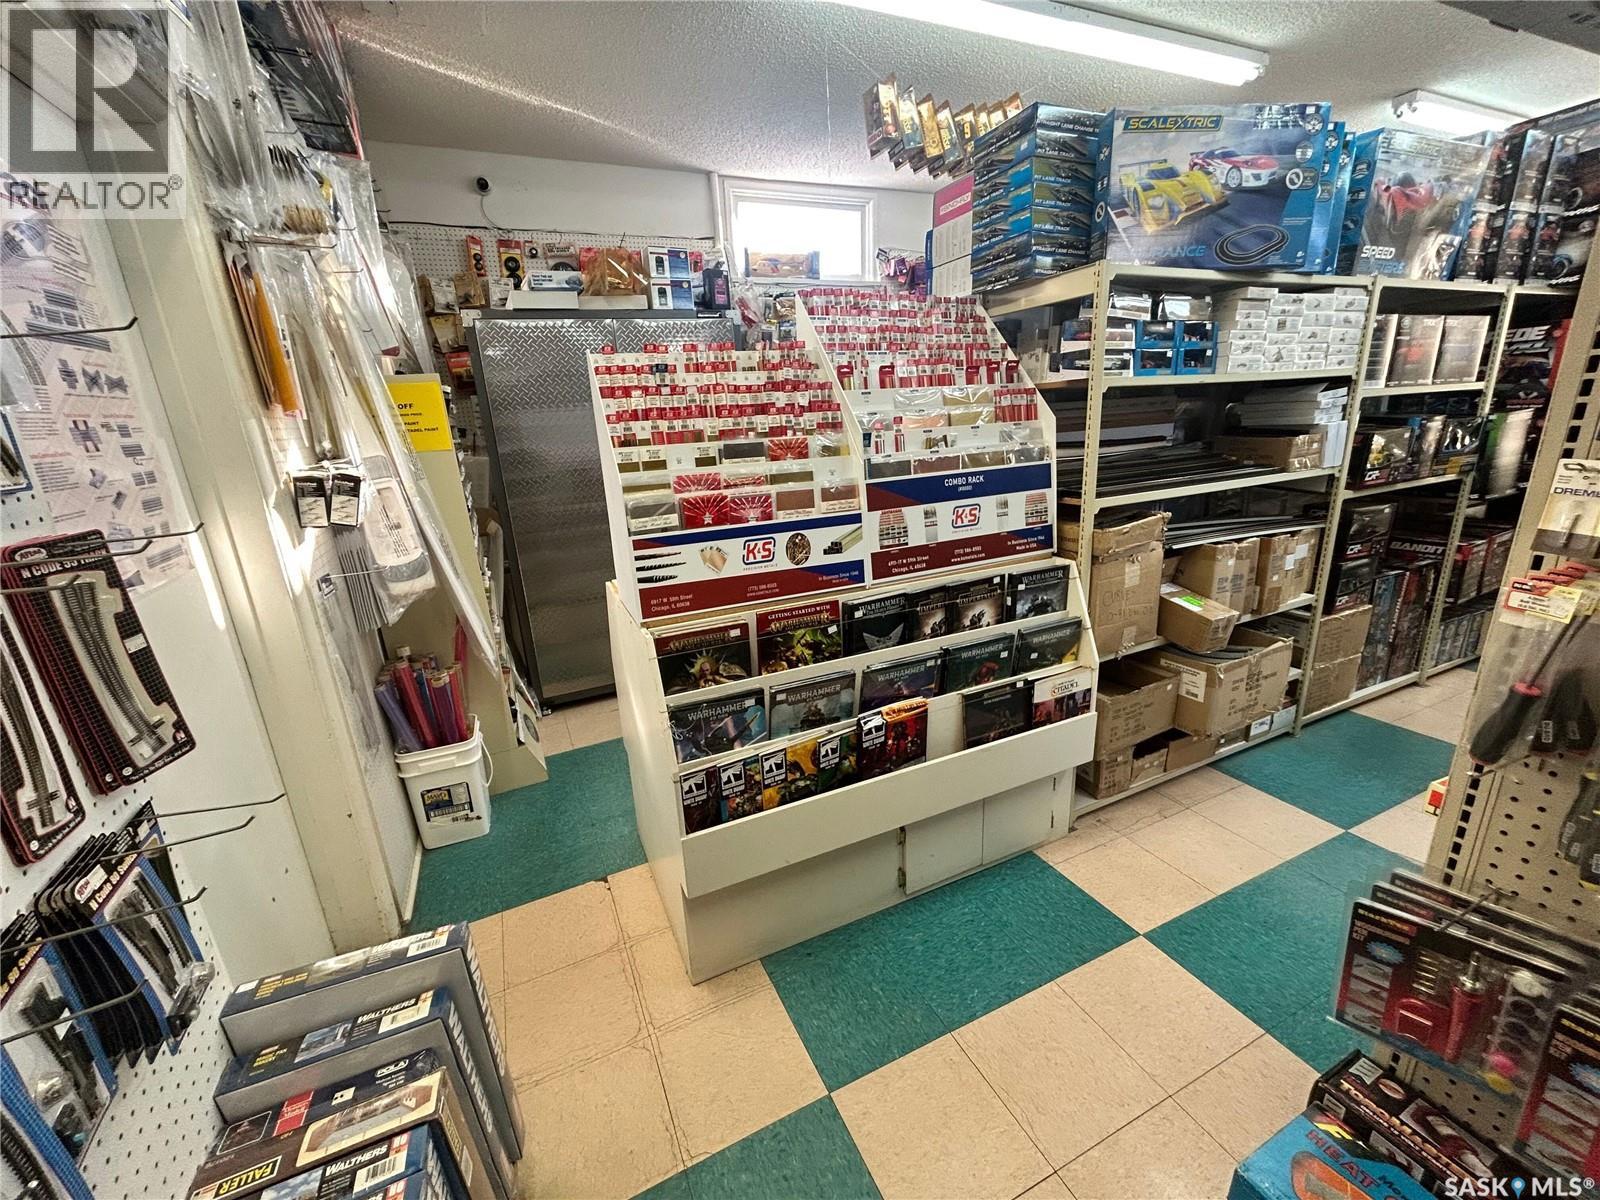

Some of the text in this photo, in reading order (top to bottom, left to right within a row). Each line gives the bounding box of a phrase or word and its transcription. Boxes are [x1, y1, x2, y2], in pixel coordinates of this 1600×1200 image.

[1127, 115, 1219, 131] SCALEXTRIC
[1361, 245, 1396, 259] SPEED
[397, 402, 414, 410] OFF
[944, 475, 984, 487] COMBO RACK
[1390, 541, 1447, 554] BANDIT
[1022, 569, 1064, 584] WARHAMMER
[768, 604, 831, 620] GETTING STARTED WITH
[859, 597, 905, 612] WARHAMMER
[1032, 629, 1070, 644] WARHAMMER
[961, 643, 1003, 659] WARHAMMER
[877, 664, 925, 682] WARHAMMER
[787, 684, 841, 702] WARHAMMER
[687, 702, 747, 721] WARHAMMER
[357, 998, 417, 1024] WALTHERS
[377, 1061, 407, 1076] POLA
[325, 1144, 388, 1177] WALTHERS
[1307, 1129, 1380, 1187] HEAT
[219, 1162, 273, 1194] FALLER
